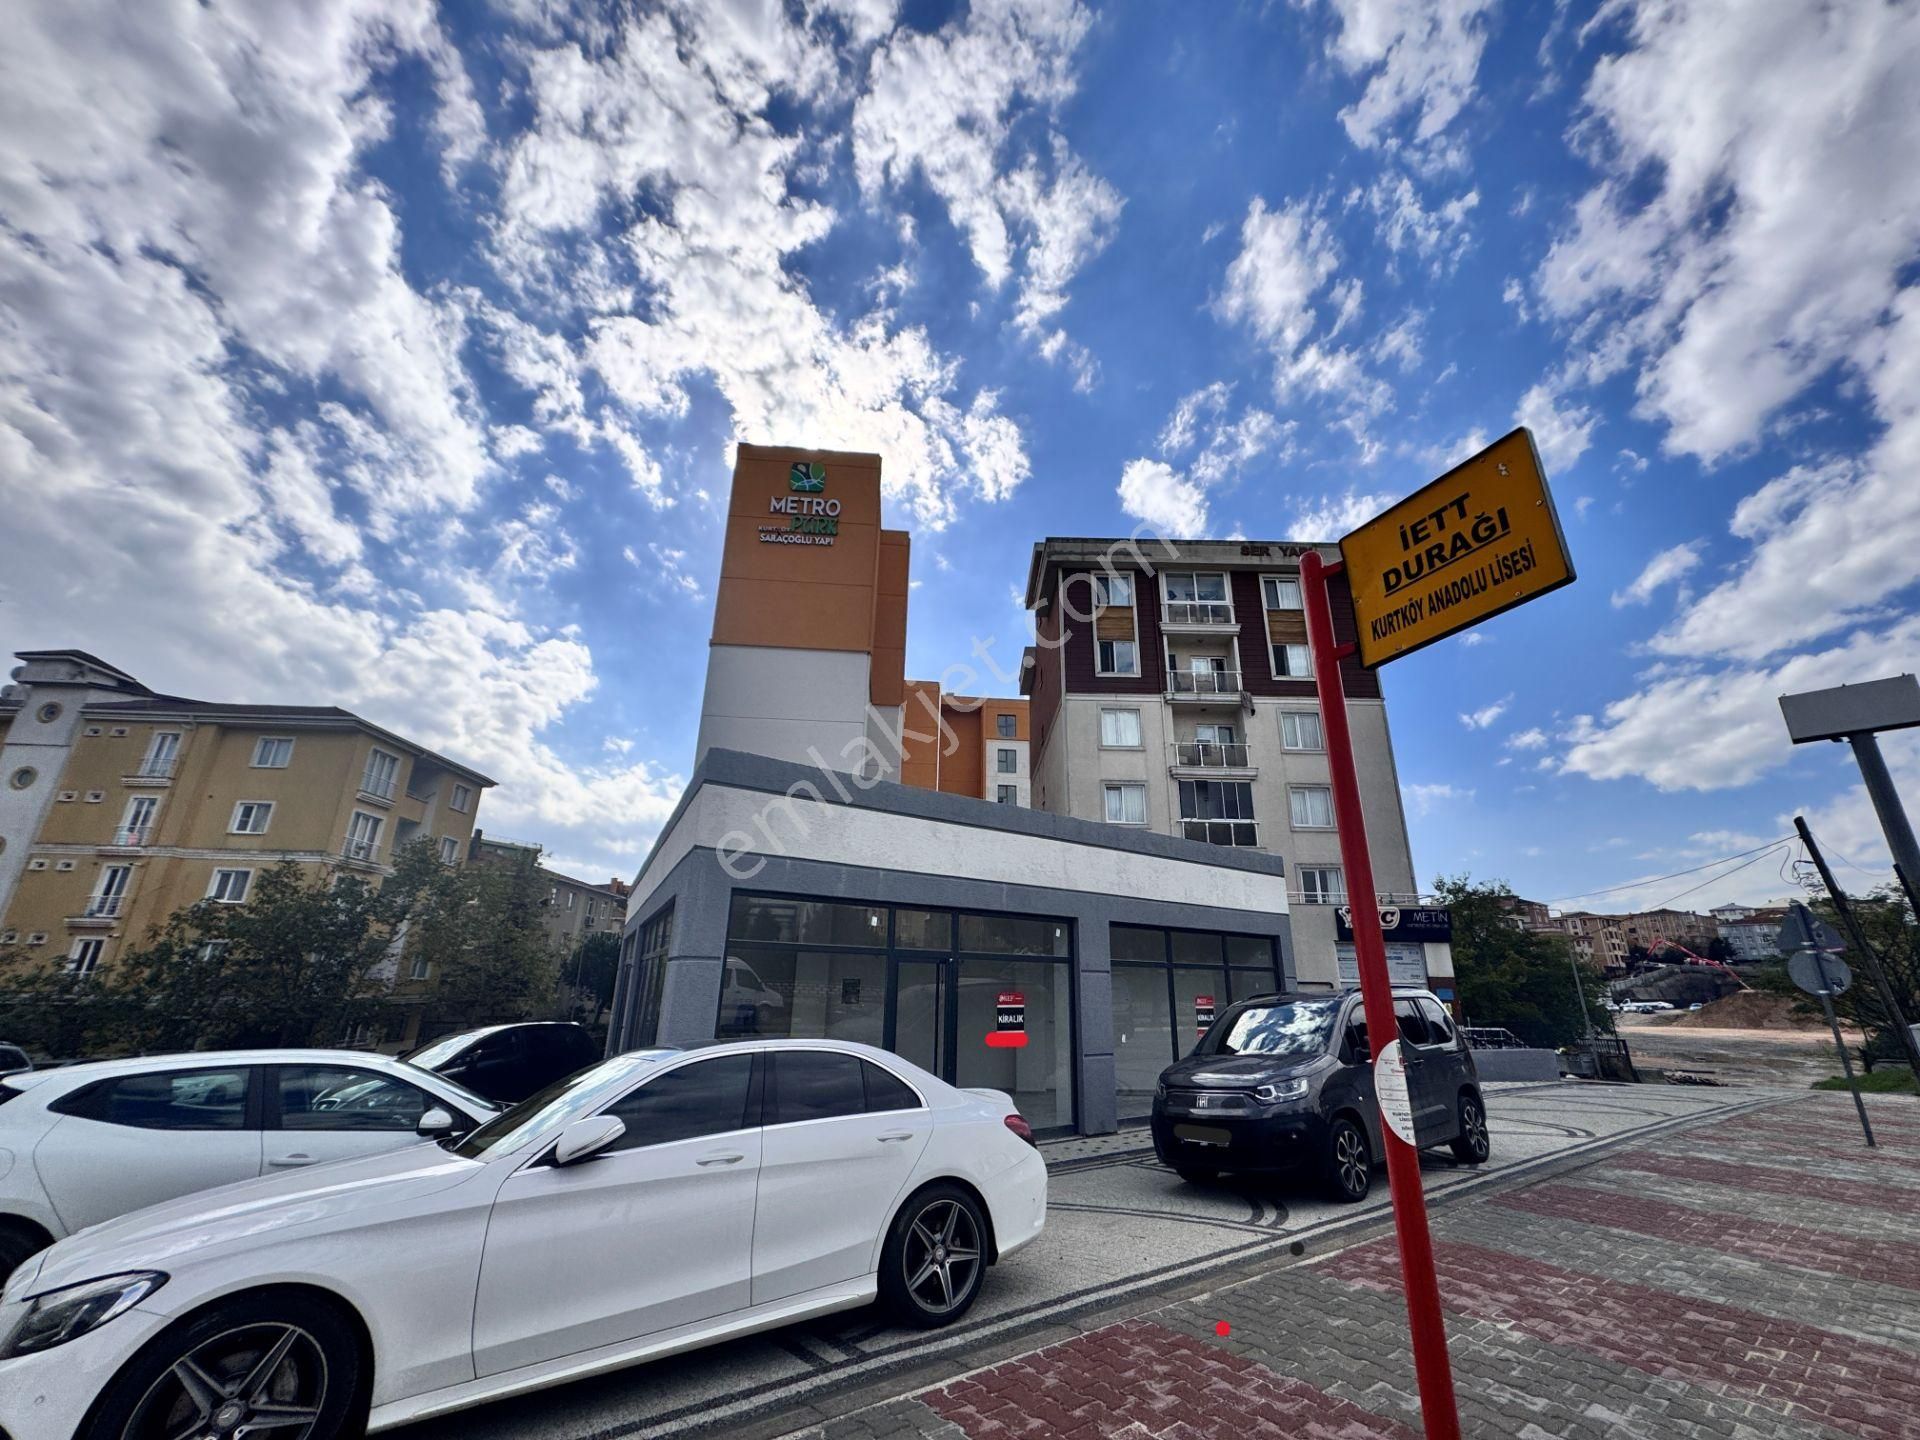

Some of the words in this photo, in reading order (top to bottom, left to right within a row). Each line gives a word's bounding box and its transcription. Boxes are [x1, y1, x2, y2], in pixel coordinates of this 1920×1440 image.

[770, 496, 841, 516] METRO
[1400, 492, 1471, 552] İETT
[815, 537, 833, 545] YAPI
[1382, 507, 1511, 593] DURAĞI
[1371, 597, 1424, 642] KURTKÖY
[1429, 567, 1488, 616] ANADOLU
[1488, 538, 1537, 587] LİSESİ
[998, 1014, 1024, 1023] KİRALIK
